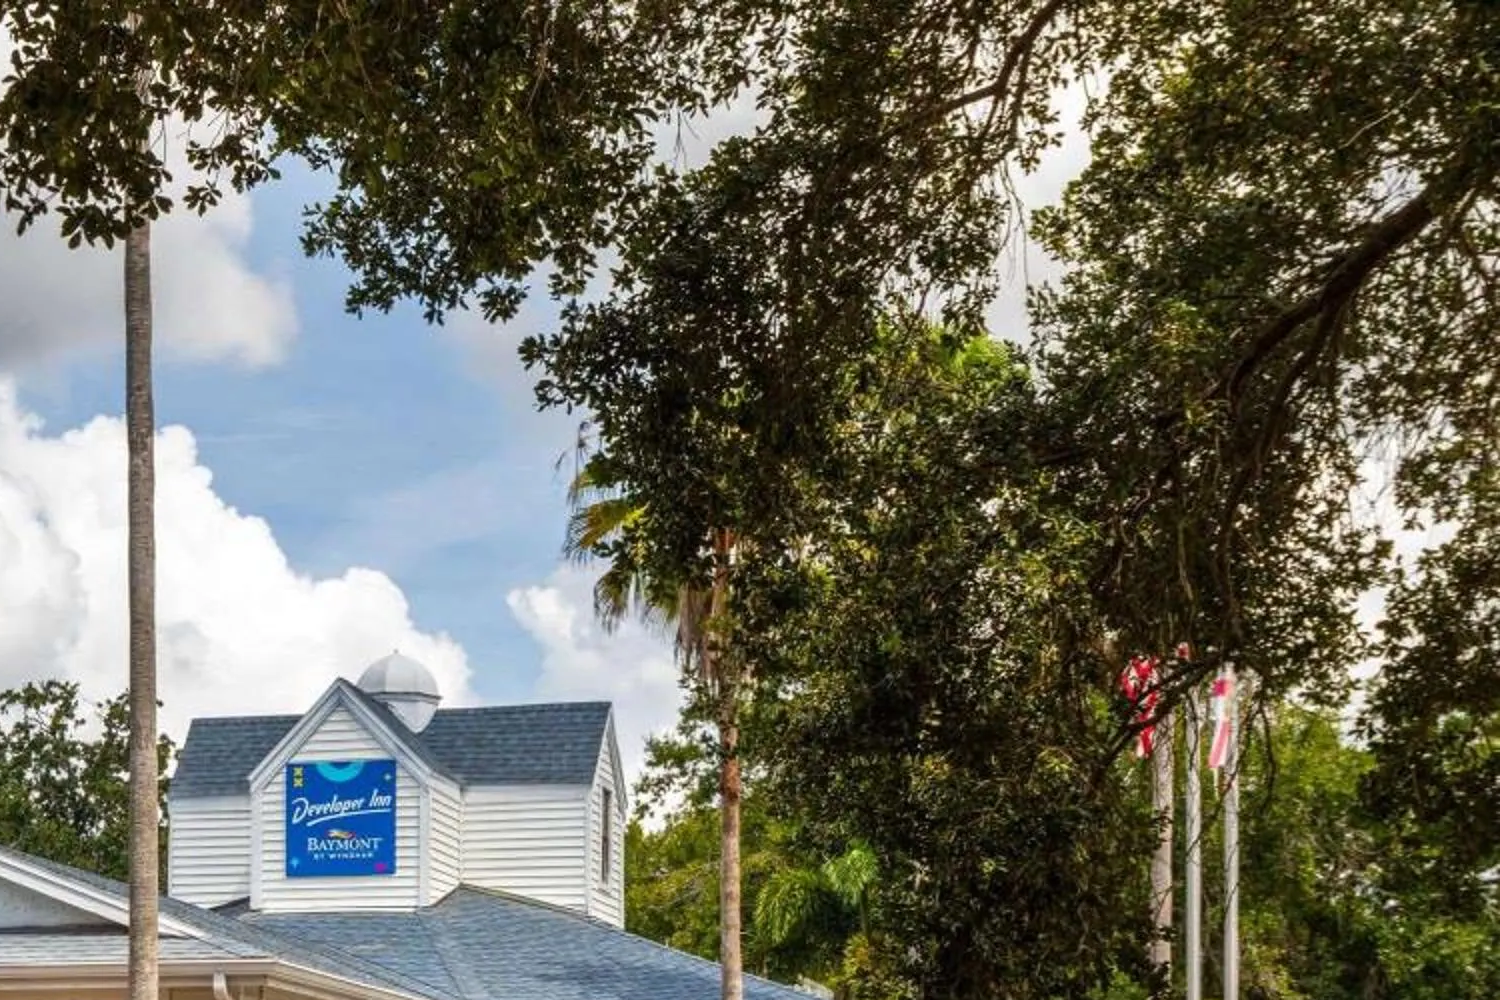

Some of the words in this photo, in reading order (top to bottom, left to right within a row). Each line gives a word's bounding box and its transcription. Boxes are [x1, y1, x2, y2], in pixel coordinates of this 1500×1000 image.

[292, 794, 365, 825] Developer
[369, 788, 392, 807] Inn
[307, 837, 383, 851] BAYMONT
